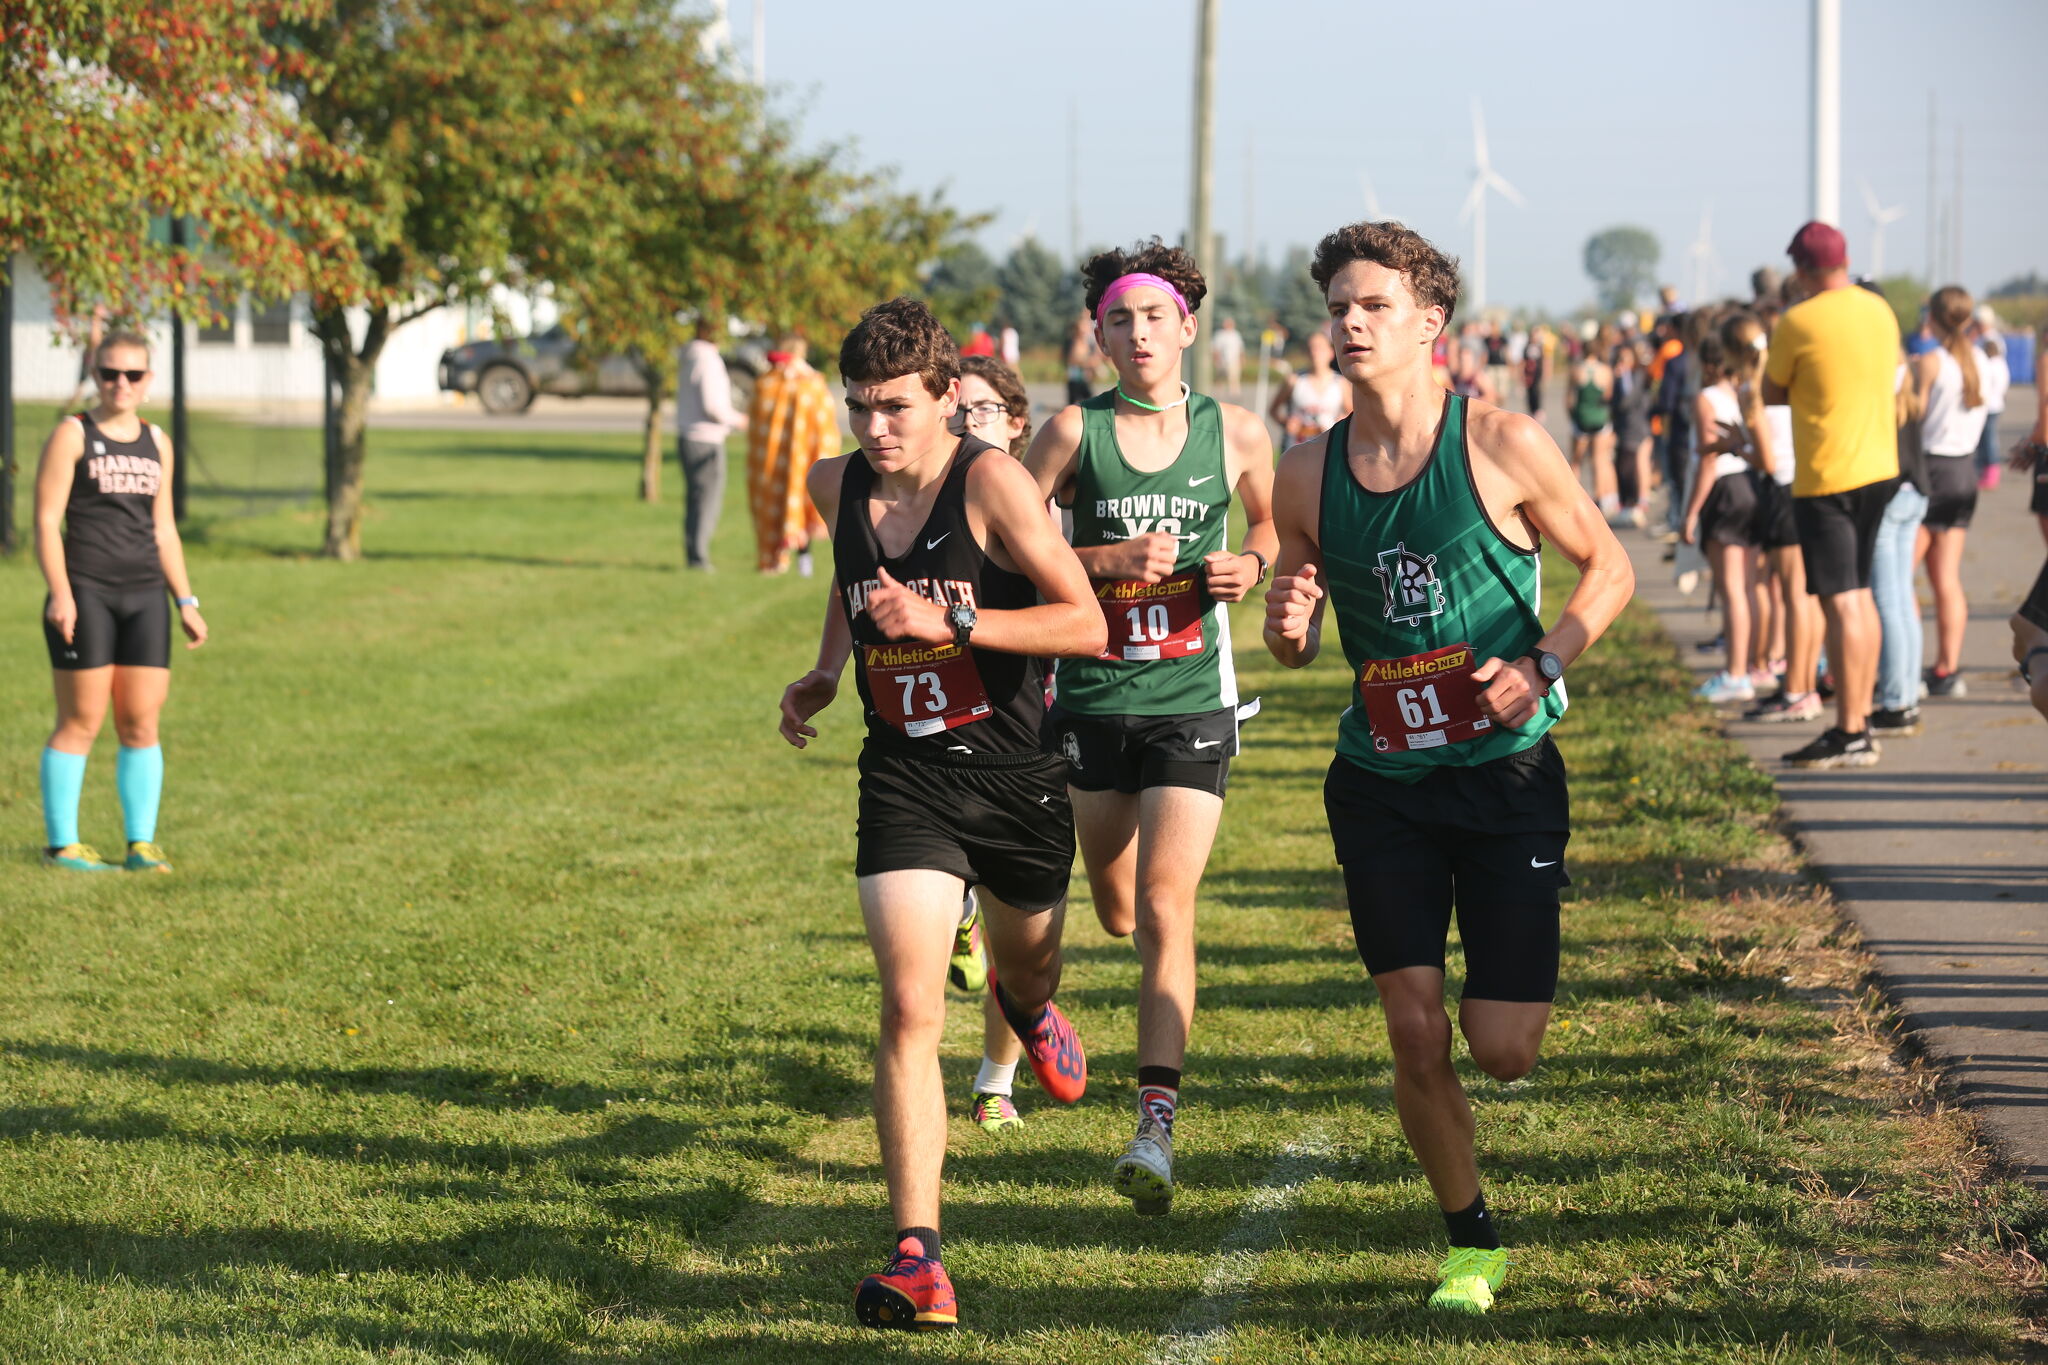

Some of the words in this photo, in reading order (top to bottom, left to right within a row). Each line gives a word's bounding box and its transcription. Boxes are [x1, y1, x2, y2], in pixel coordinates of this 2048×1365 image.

[1096, 494, 1166, 518] BROWN
[1170, 496, 1209, 521] CITY
[1126, 604, 1169, 642] 10
[1363, 660, 1437, 682] Athletic
[895, 671, 948, 716] 73
[1397, 684, 1449, 728] 61
